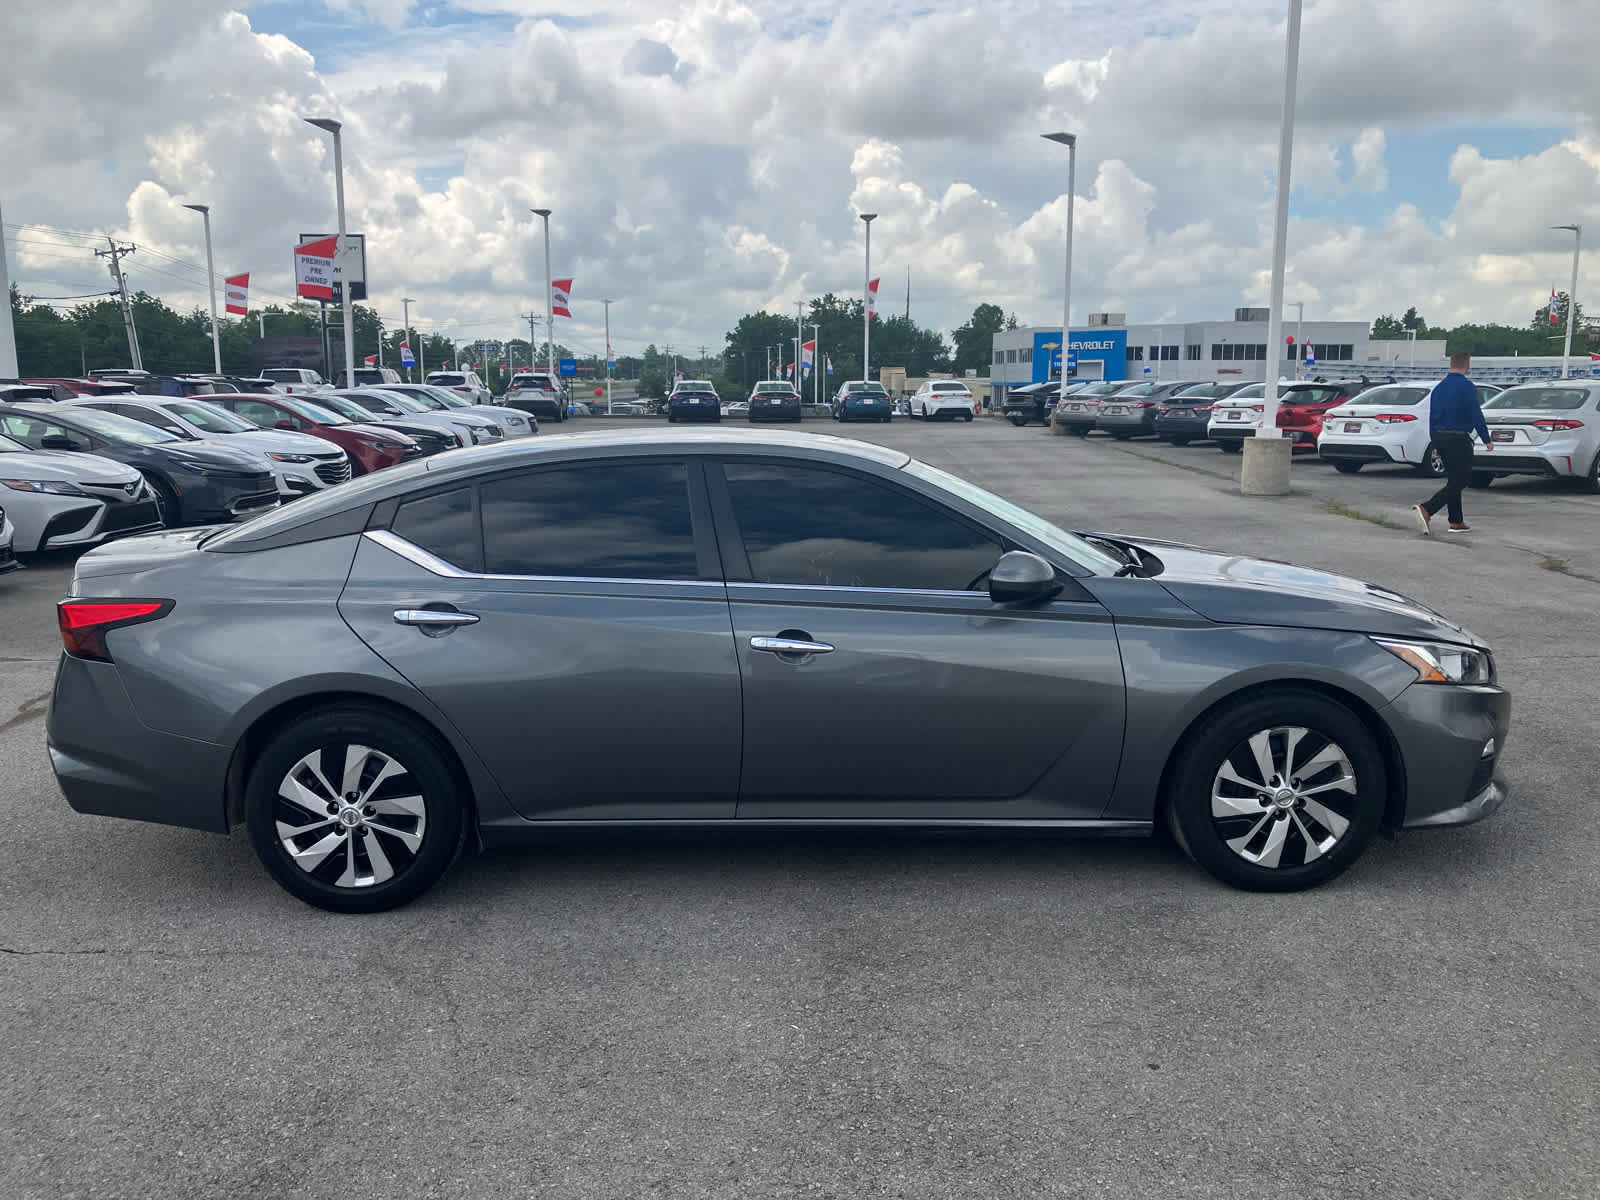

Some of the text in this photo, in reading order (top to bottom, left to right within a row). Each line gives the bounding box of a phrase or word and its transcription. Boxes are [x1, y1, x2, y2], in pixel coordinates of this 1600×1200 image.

[301, 256, 331, 266] PREMIUM
[310, 267, 322, 275] PRE
[304, 275, 328, 285] OWNED
[1066, 340, 1115, 350] HEVROLET
